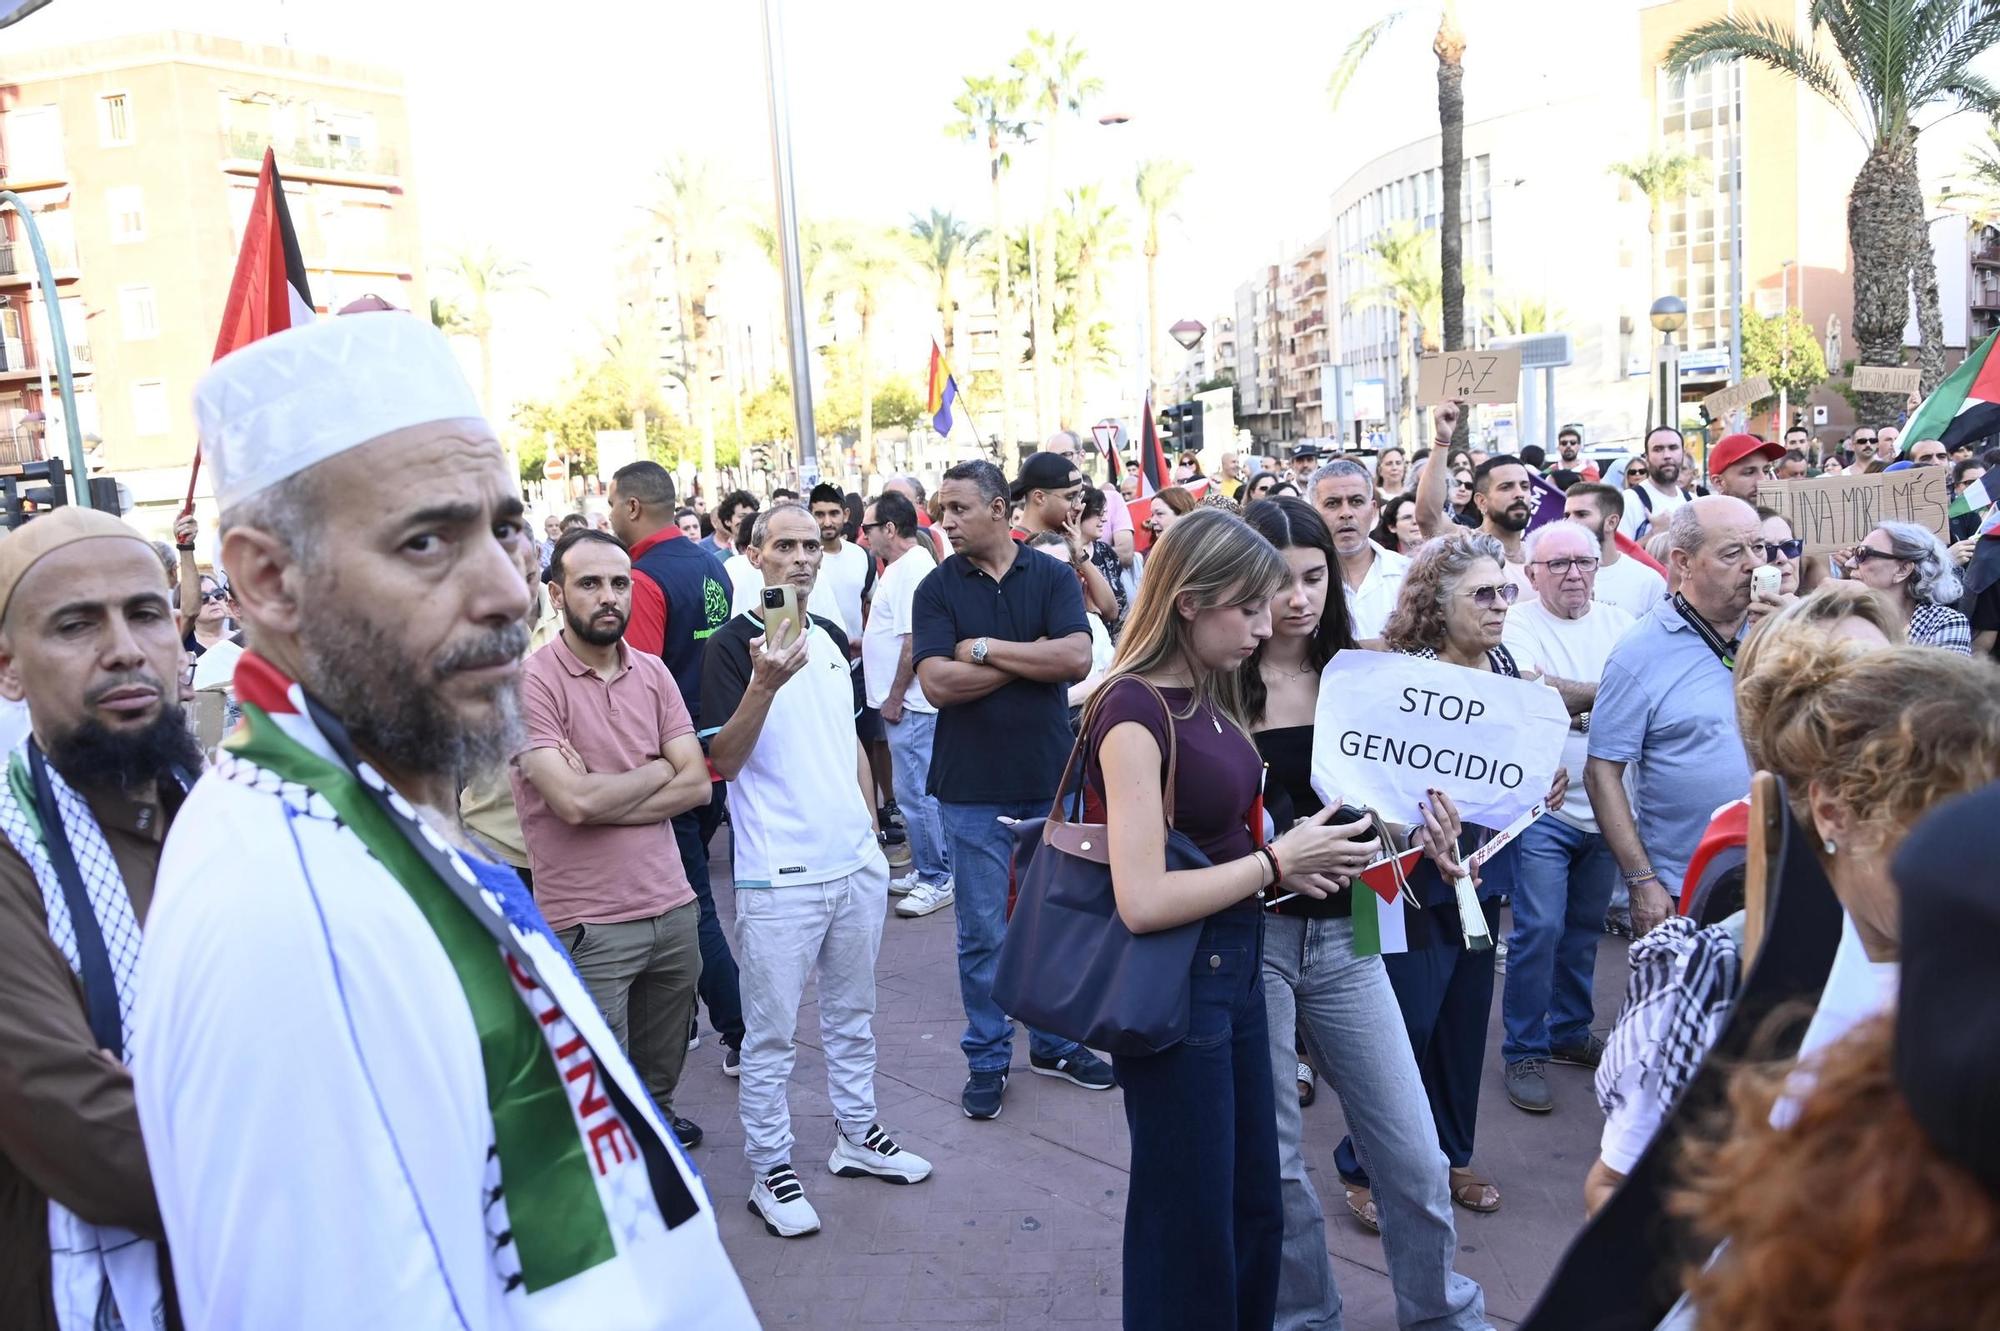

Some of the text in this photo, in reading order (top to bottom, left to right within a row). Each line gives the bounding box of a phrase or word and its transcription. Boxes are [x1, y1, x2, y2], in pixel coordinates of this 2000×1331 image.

[1442, 356, 1498, 396] PAZ
[1457, 387, 1470, 396] 16
[1790, 473, 1946, 545] UNA MORT MÉS
[1399, 687, 1485, 725] STOP
[1339, 730, 1524, 789] GENOCIDIO
